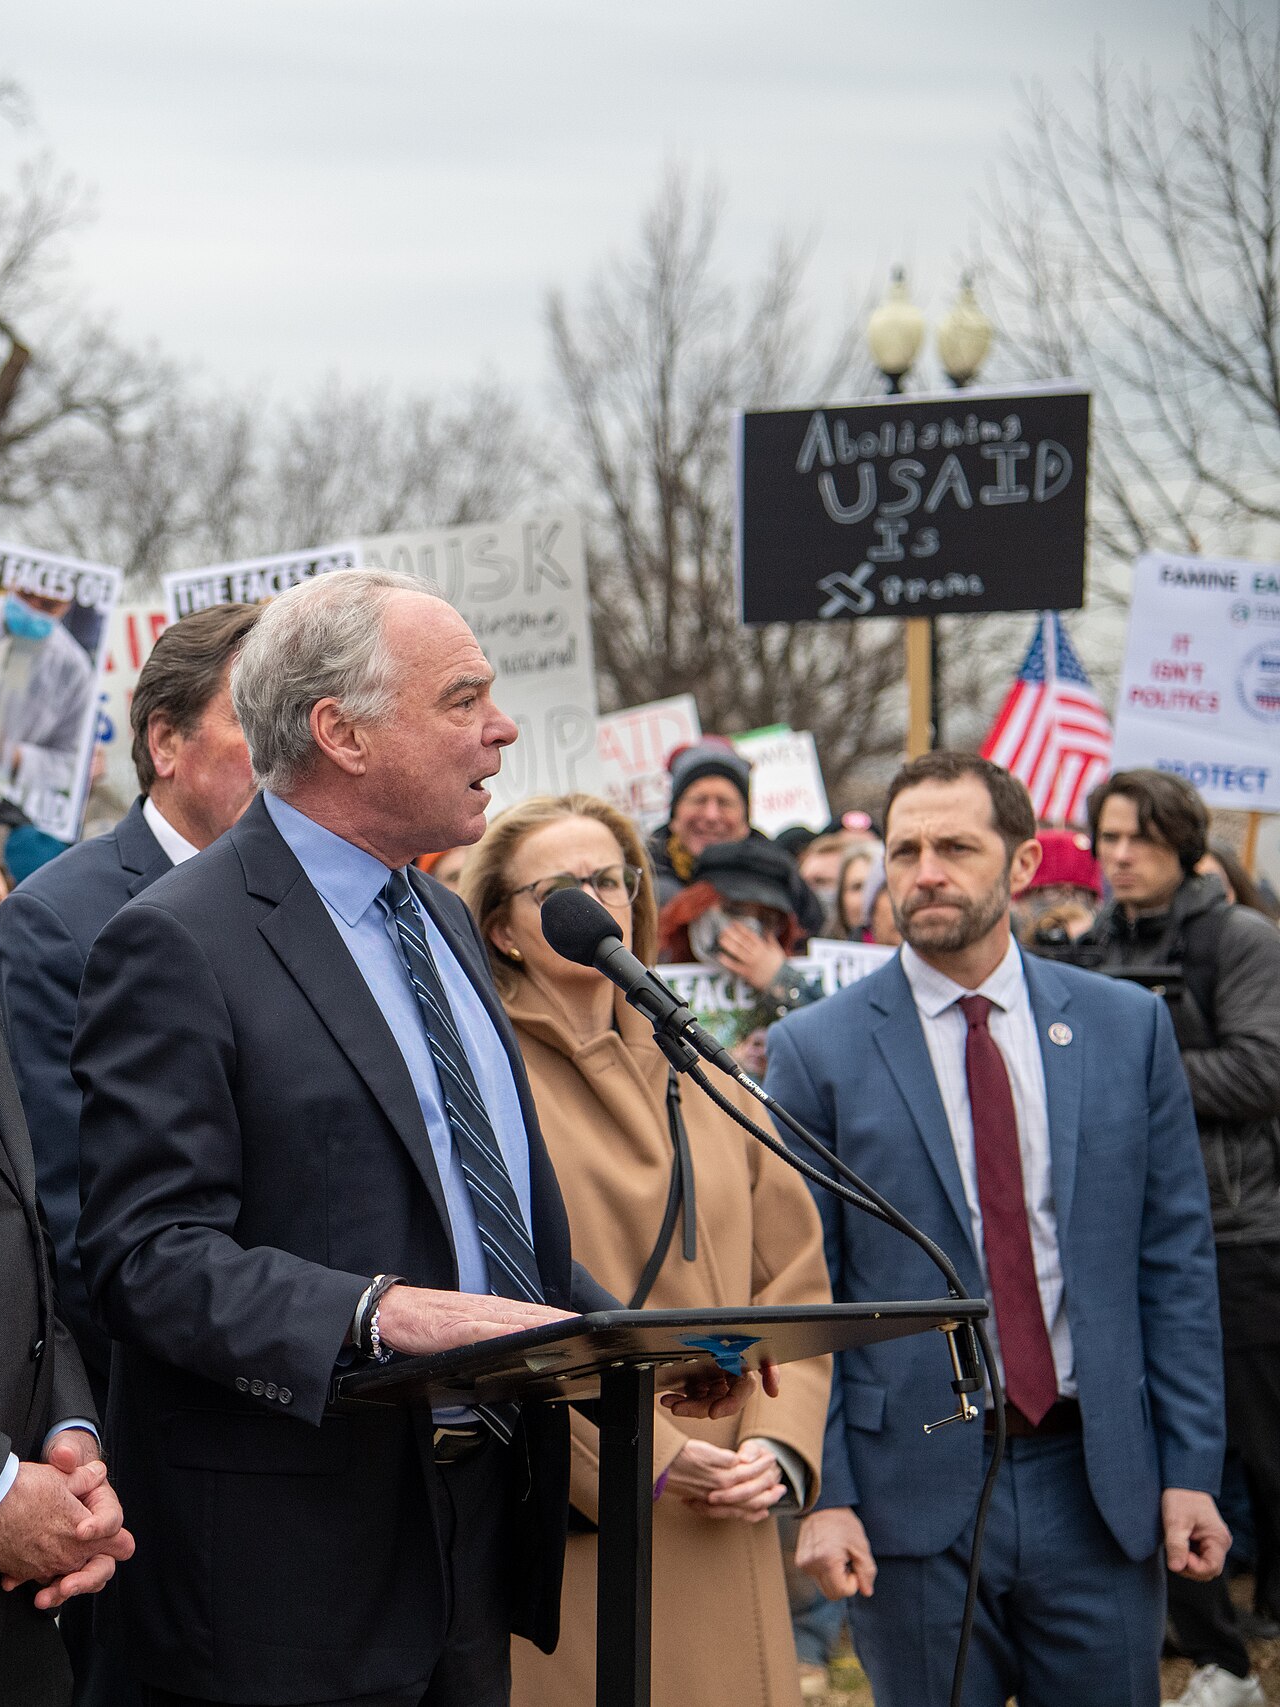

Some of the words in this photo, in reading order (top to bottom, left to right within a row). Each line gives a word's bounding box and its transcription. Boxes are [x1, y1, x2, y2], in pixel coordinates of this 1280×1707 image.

[796, 411, 1021, 473] Abolishing
[818, 440, 1073, 525] USAID
[867, 517, 940, 562] Is
[1160, 564, 1240, 593] FAMINE
[1172, 632, 1191, 655] IT
[1129, 686, 1220, 713] POLITICS
